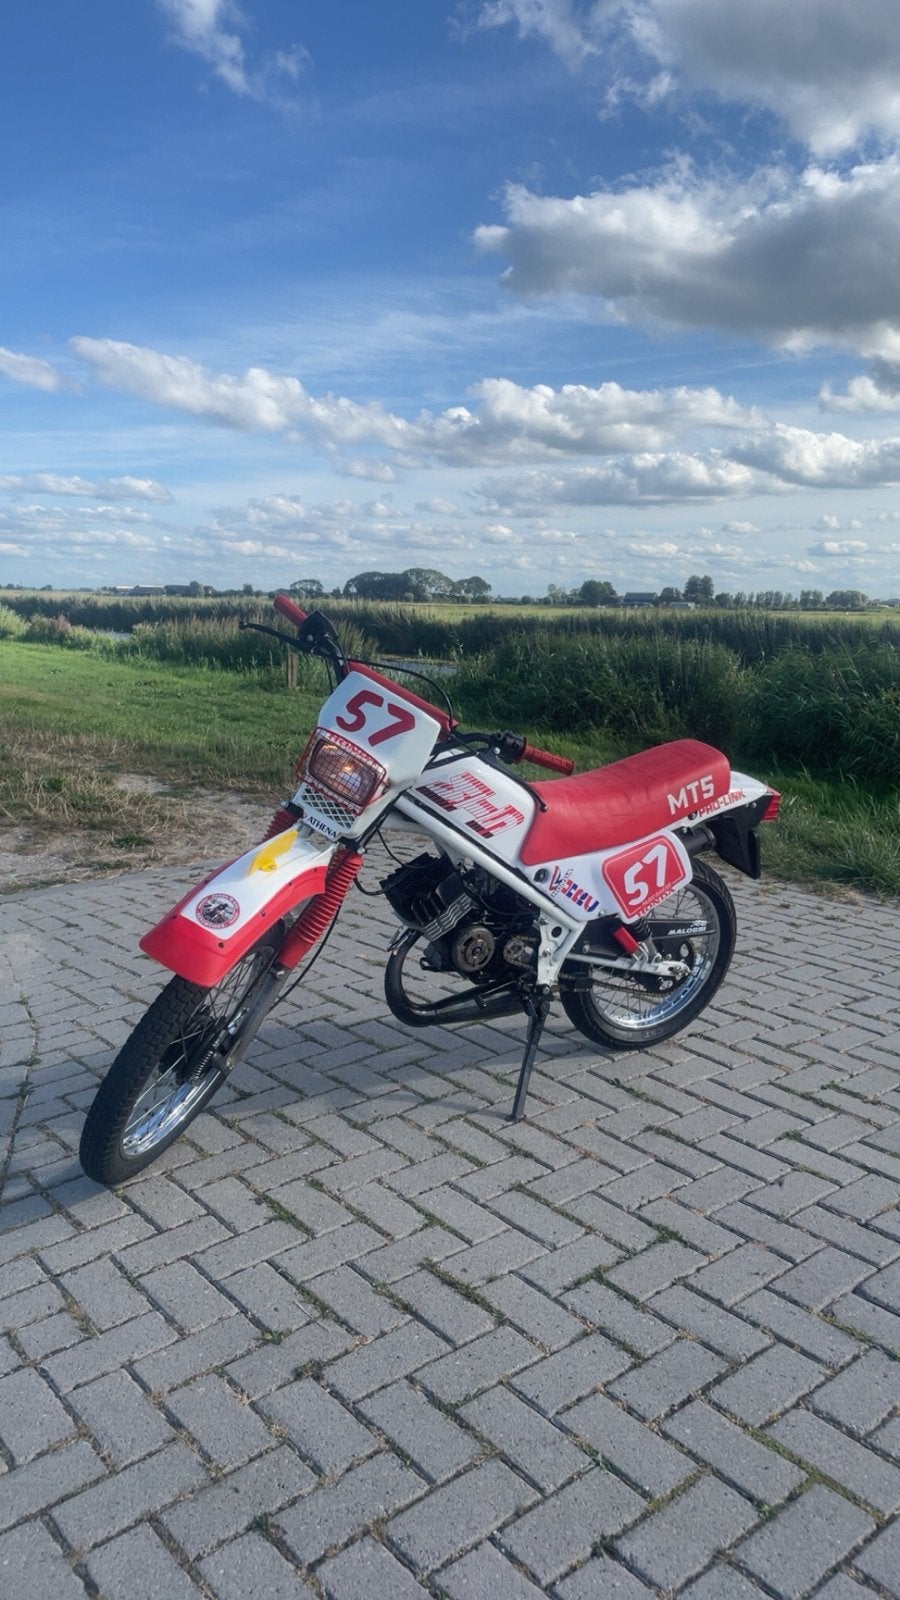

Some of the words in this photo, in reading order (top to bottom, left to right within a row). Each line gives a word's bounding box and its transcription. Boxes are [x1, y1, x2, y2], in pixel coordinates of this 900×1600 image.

[336, 690, 416, 747] 57
[666, 774, 715, 815] MT5
[700, 789, 746, 817] PRO-LINK
[308, 816, 337, 838] ATHENA
[624, 844, 668, 906] 57
[668, 926, 707, 936] MALOSSI
